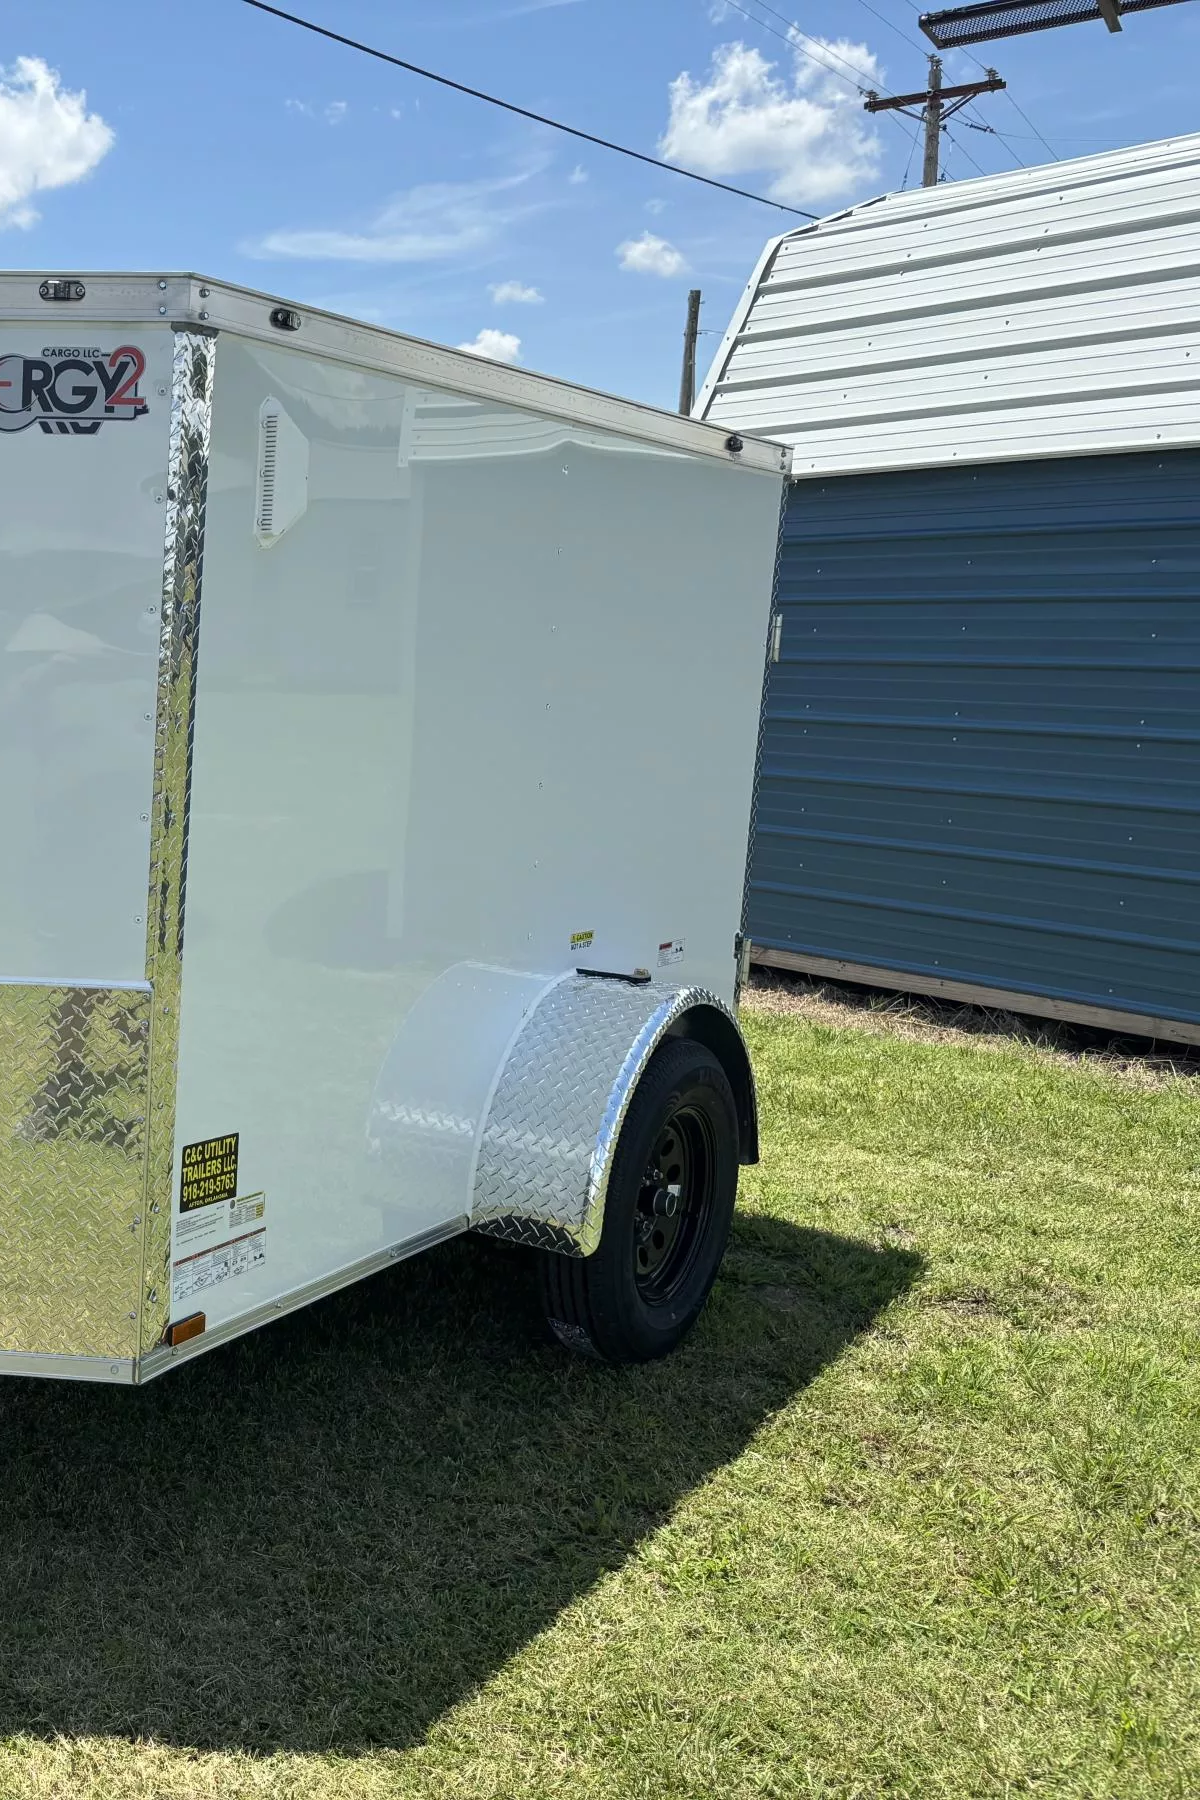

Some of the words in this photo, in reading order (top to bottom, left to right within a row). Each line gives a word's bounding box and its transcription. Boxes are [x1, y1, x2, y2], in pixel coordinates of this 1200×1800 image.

[42, 348, 80, 358] CARGO
[83, 348, 100, 358] LLC
[185, 1145, 203, 1164] C&C
[205, 1136, 237, 1159] UTILITY
[183, 1158, 222, 1183] TRAILERS
[183, 1172, 235, 1202] 918-219-5763
